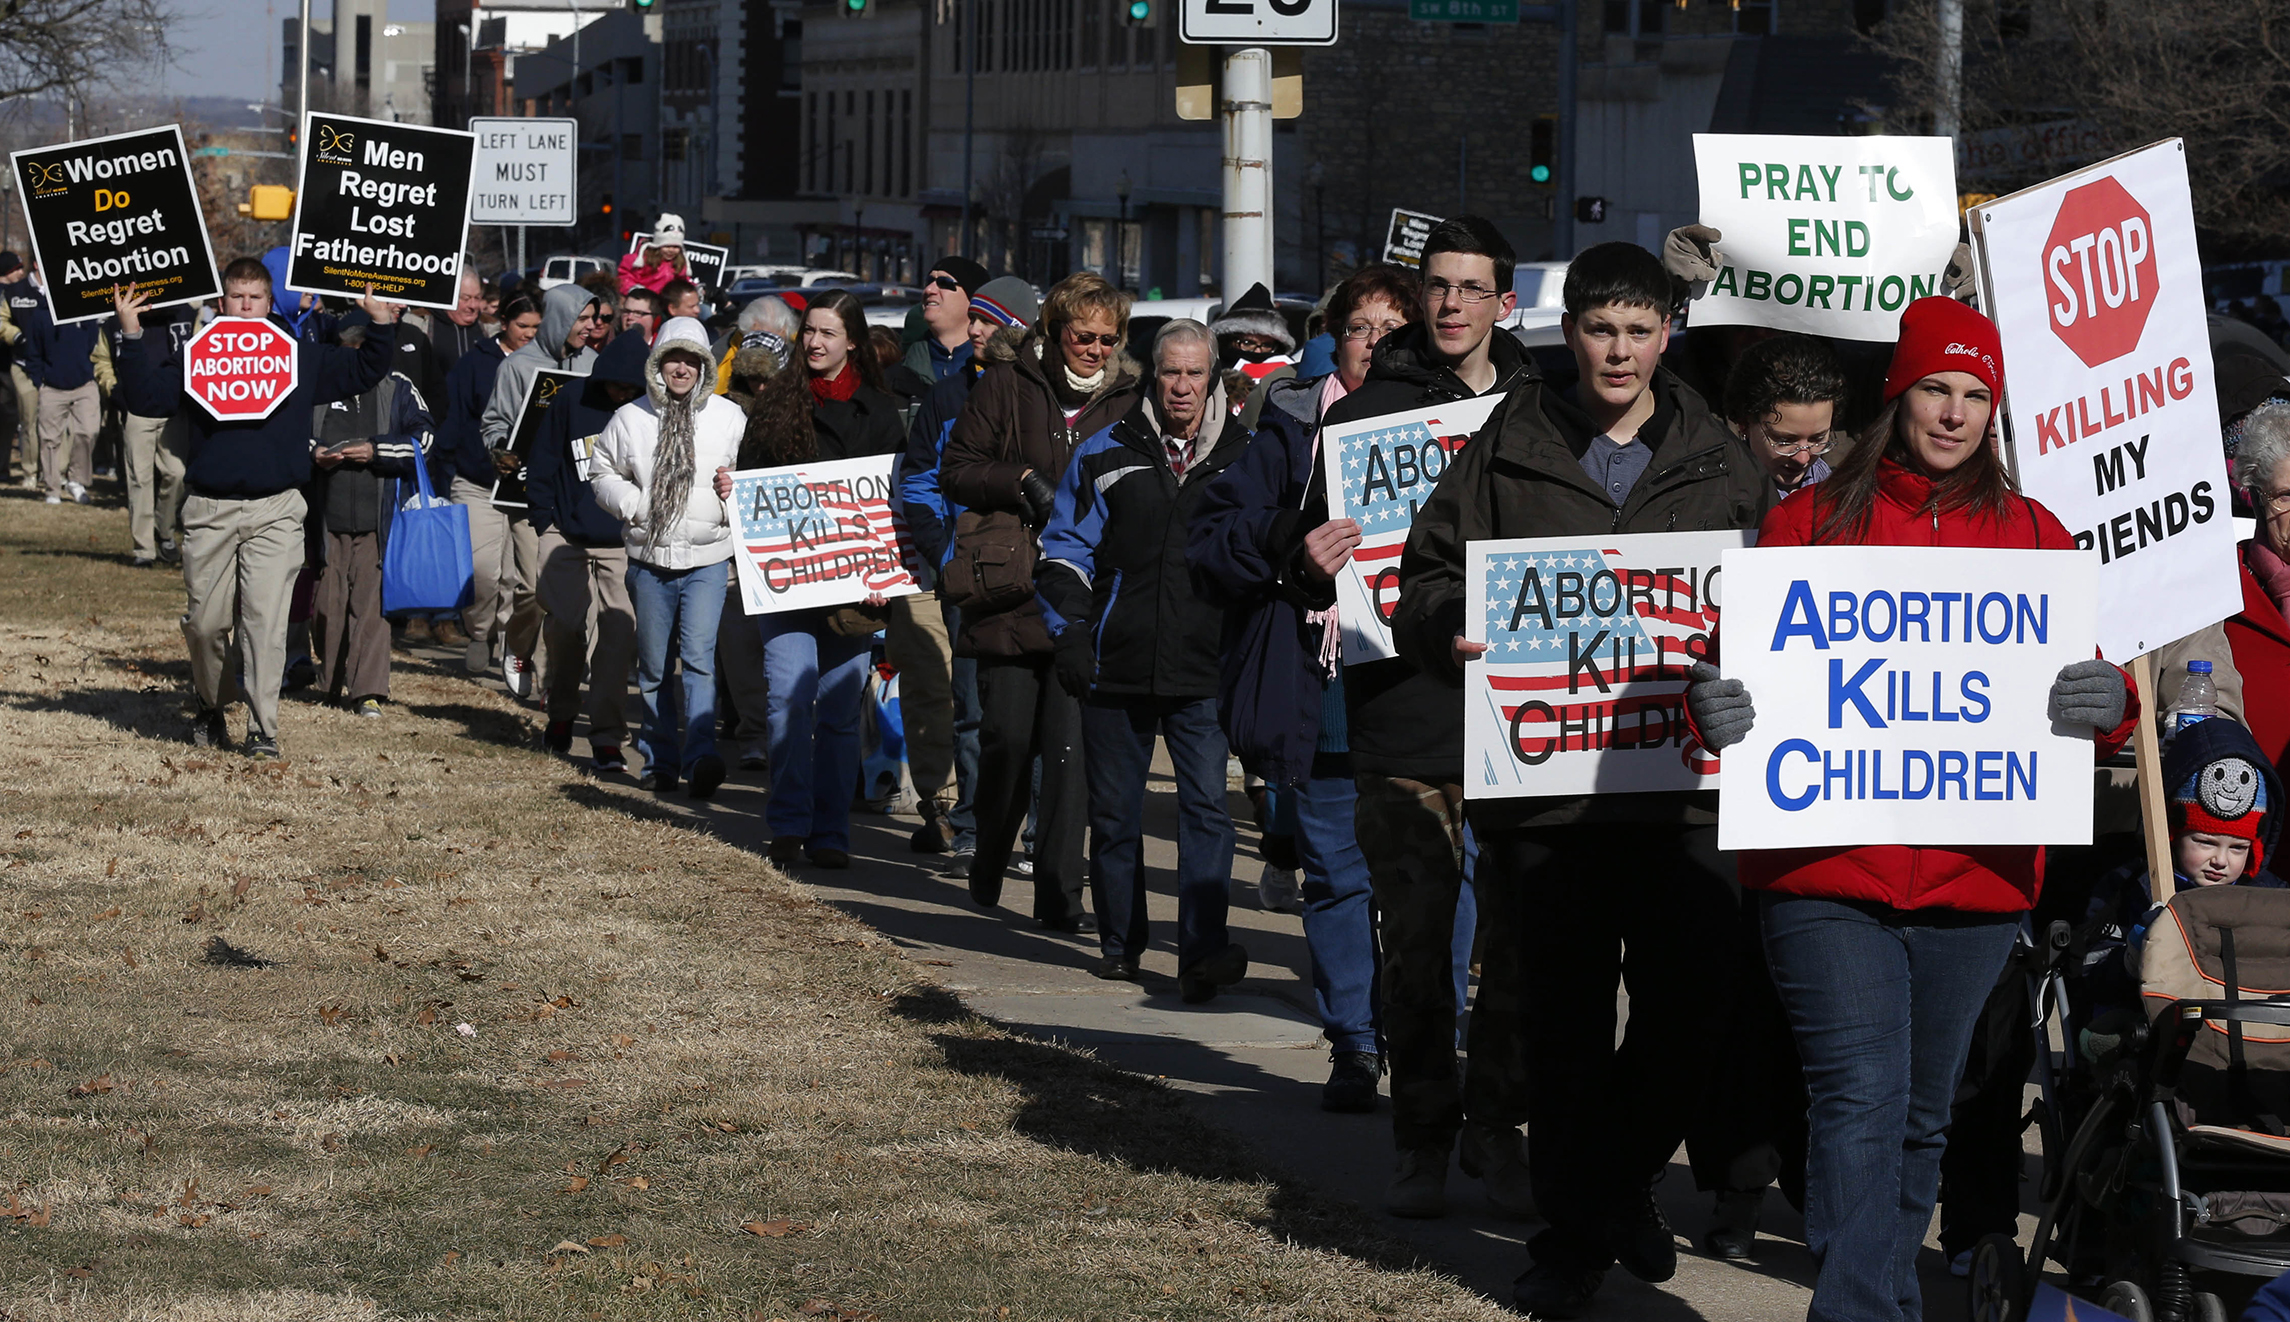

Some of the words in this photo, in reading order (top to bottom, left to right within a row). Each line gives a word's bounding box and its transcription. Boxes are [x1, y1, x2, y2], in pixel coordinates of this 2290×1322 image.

[1420, 3, 1440, 14] SW
[1448, 1, 1482, 15] 8th
[363, 139, 424, 172] Men
[481, 134, 516, 149] LEFT
[528, 134, 567, 150] LANE
[64, 148, 177, 184] Women
[496, 163, 548, 182] MUST
[1738, 162, 1843, 203] PRAY
[1859, 164, 1915, 203] TO
[94, 188, 131, 212] Do
[339, 170, 437, 208] Regret
[479, 194, 518, 209] TURN
[530, 194, 567, 210] LEFT
[66, 208, 166, 246] Regret
[351, 206, 416, 238] Lost
[1787, 218, 1871, 258] END
[64, 246, 190, 285] Abortion
[296, 232, 459, 276] Fatherhood
[2048, 216, 2149, 328] STOP
[344, 279, 404, 293] 1-800-95-HELP
[1710, 265, 1937, 312] ABORTION
[208, 332, 274, 353] STOP
[1944, 342, 1979, 358] Catholic
[192, 355, 290, 377] ABORTION
[207, 379, 277, 402] NOW
[2035, 357, 2194, 456] KILLING
[2093, 434, 2150, 496] MY
[752, 473, 896, 522] ABORTION
[786, 513, 870, 553] KILLS
[2073, 481, 2214, 565] IENDS
[763, 545, 906, 594] CHILDREN
[1508, 565, 1721, 632] ABORTIO
[1770, 579, 2048, 651] ABORTION
[1828, 658, 1991, 729] KILLS
[1510, 700, 1688, 766] CHILD
[1766, 738, 2037, 812] CHILDREN
